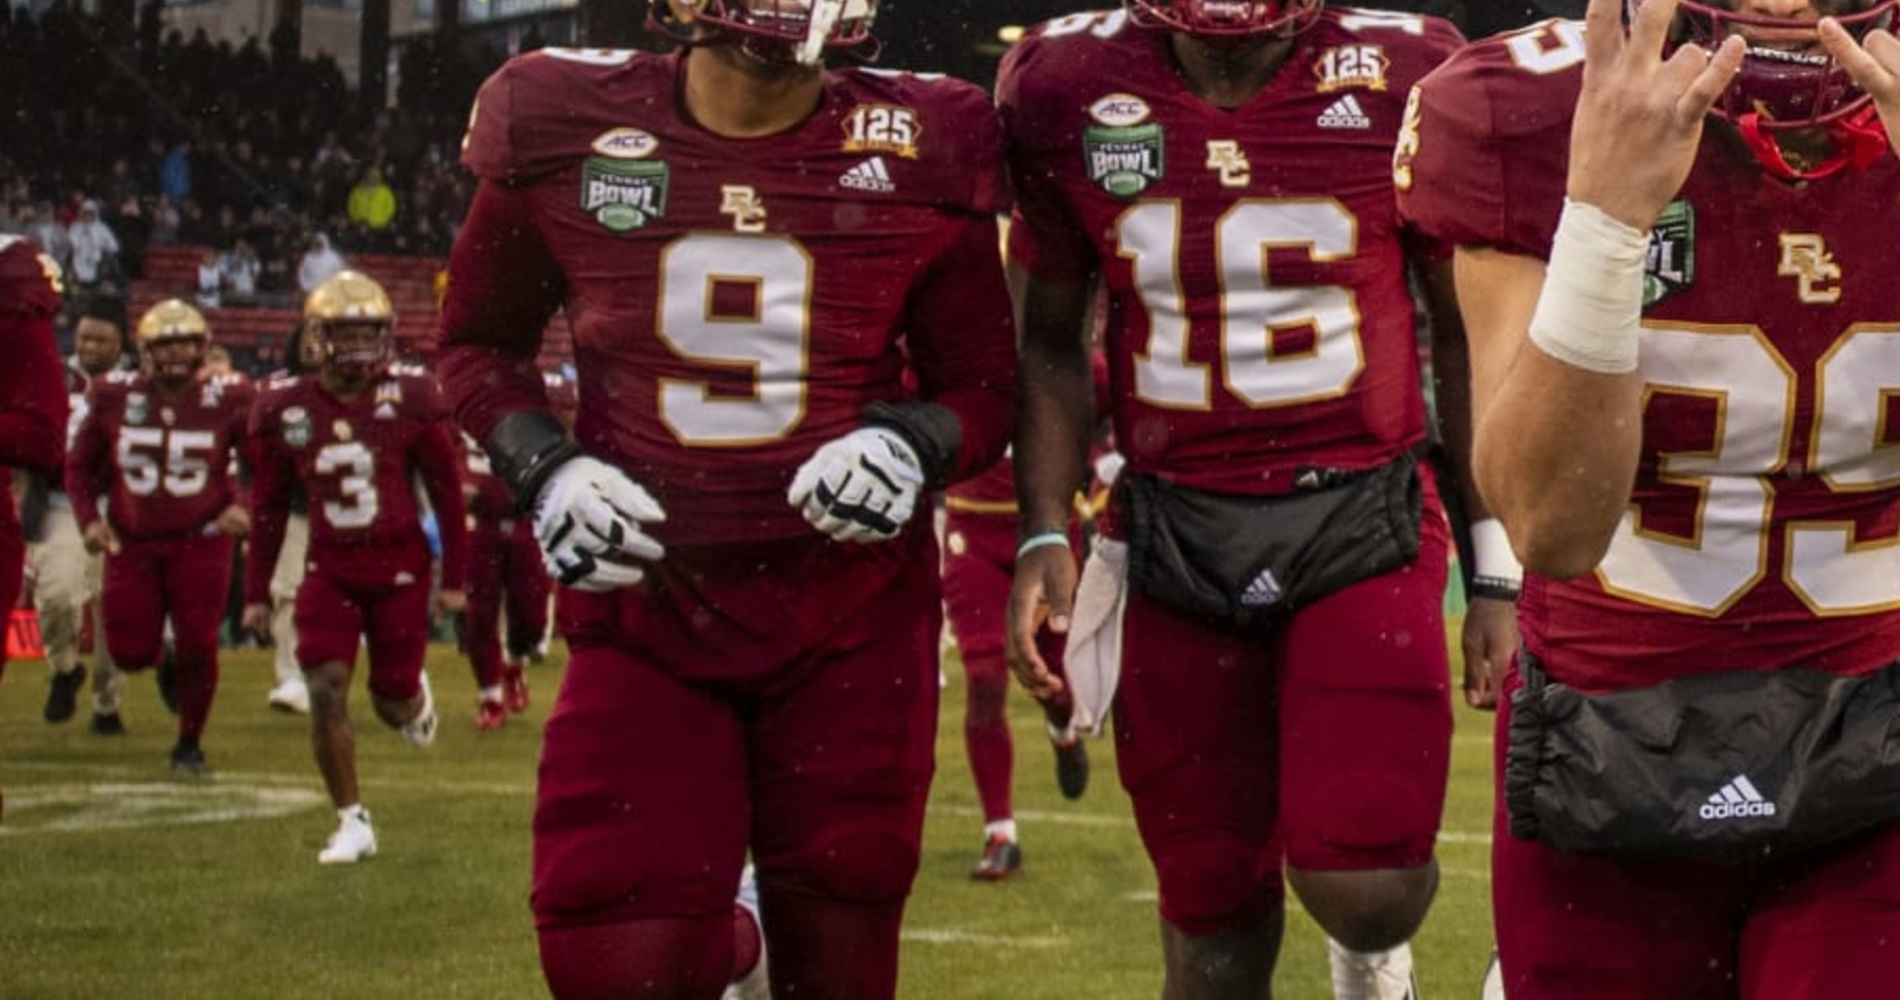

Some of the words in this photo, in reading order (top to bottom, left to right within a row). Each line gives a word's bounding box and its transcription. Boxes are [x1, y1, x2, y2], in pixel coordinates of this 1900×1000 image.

[1321, 47, 1383, 81] 125
[853, 108, 913, 145] 125
[1099, 102, 1140, 115] ACC
[603, 134, 649, 149] ACC
[1091, 149, 1157, 180] BOWL
[588, 180, 658, 218] BOWL
[1113, 196, 1366, 411] 16
[656, 232, 815, 447] 9
[118, 426, 214, 497] 55
[314, 442, 378, 529] 3
[1698, 800, 1776, 820] adidas
